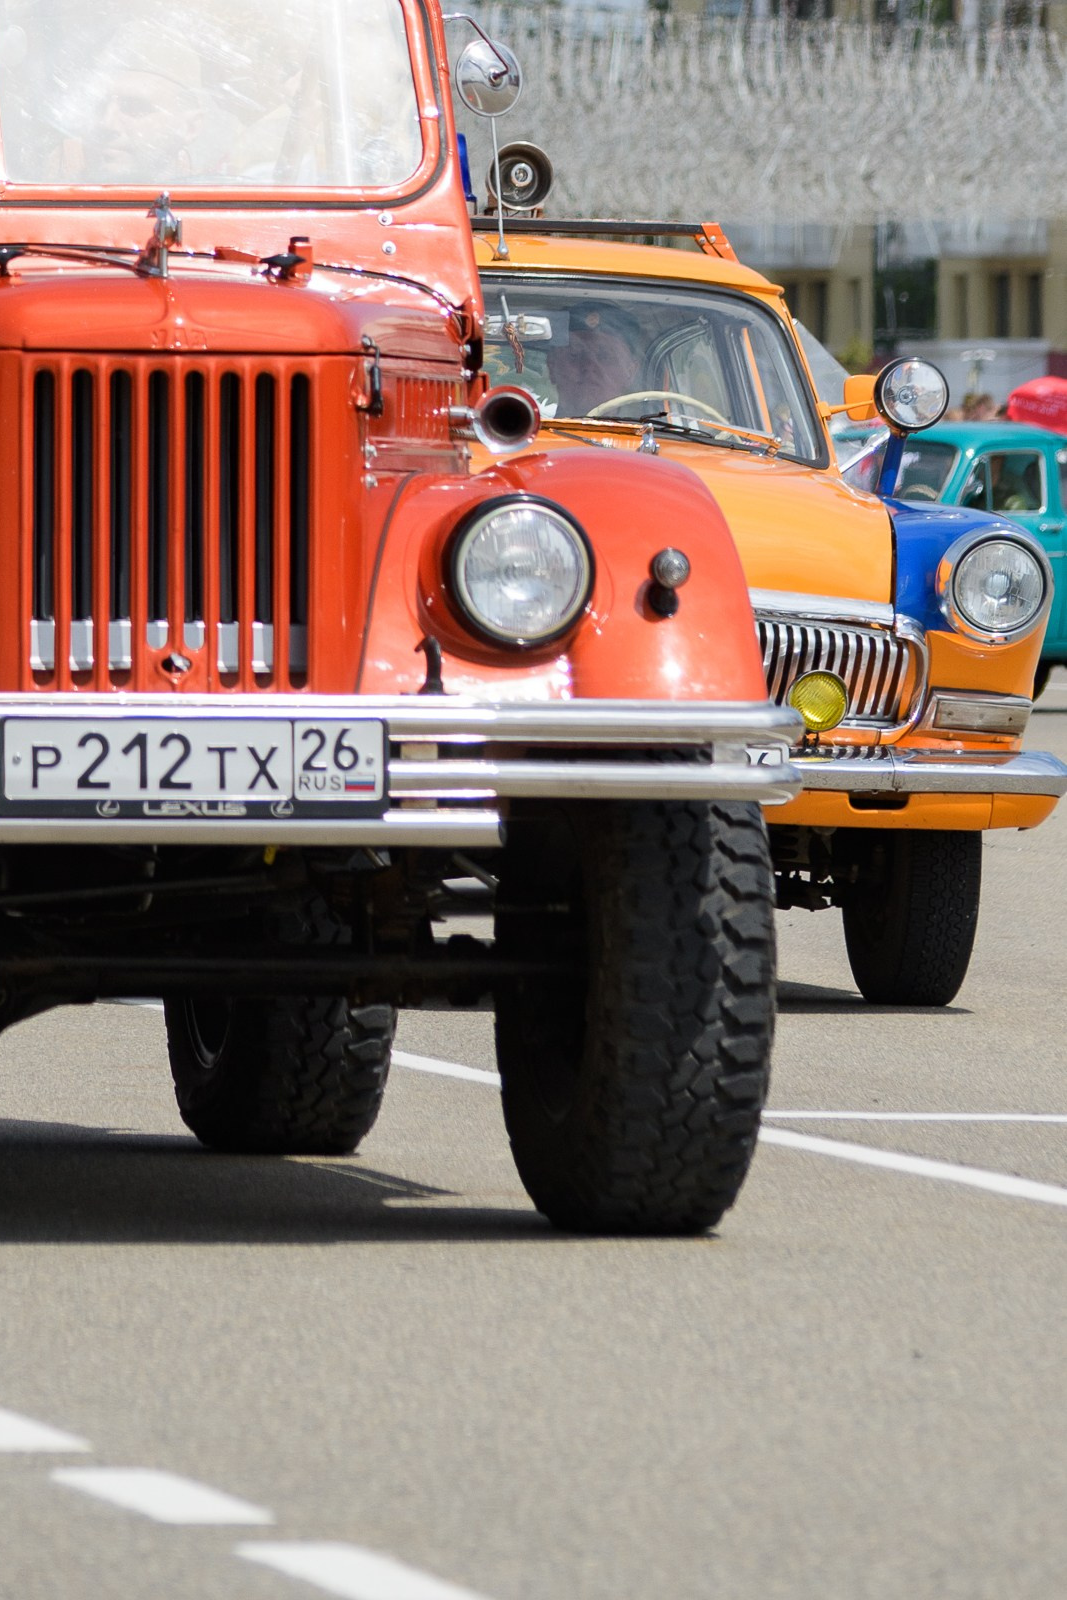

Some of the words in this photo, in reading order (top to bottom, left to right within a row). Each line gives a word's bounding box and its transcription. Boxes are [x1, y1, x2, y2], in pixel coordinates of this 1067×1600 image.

[301, 728, 359, 771] 26
[298, 775, 342, 792] RUS
[142, 800, 248, 817] LEXUS
